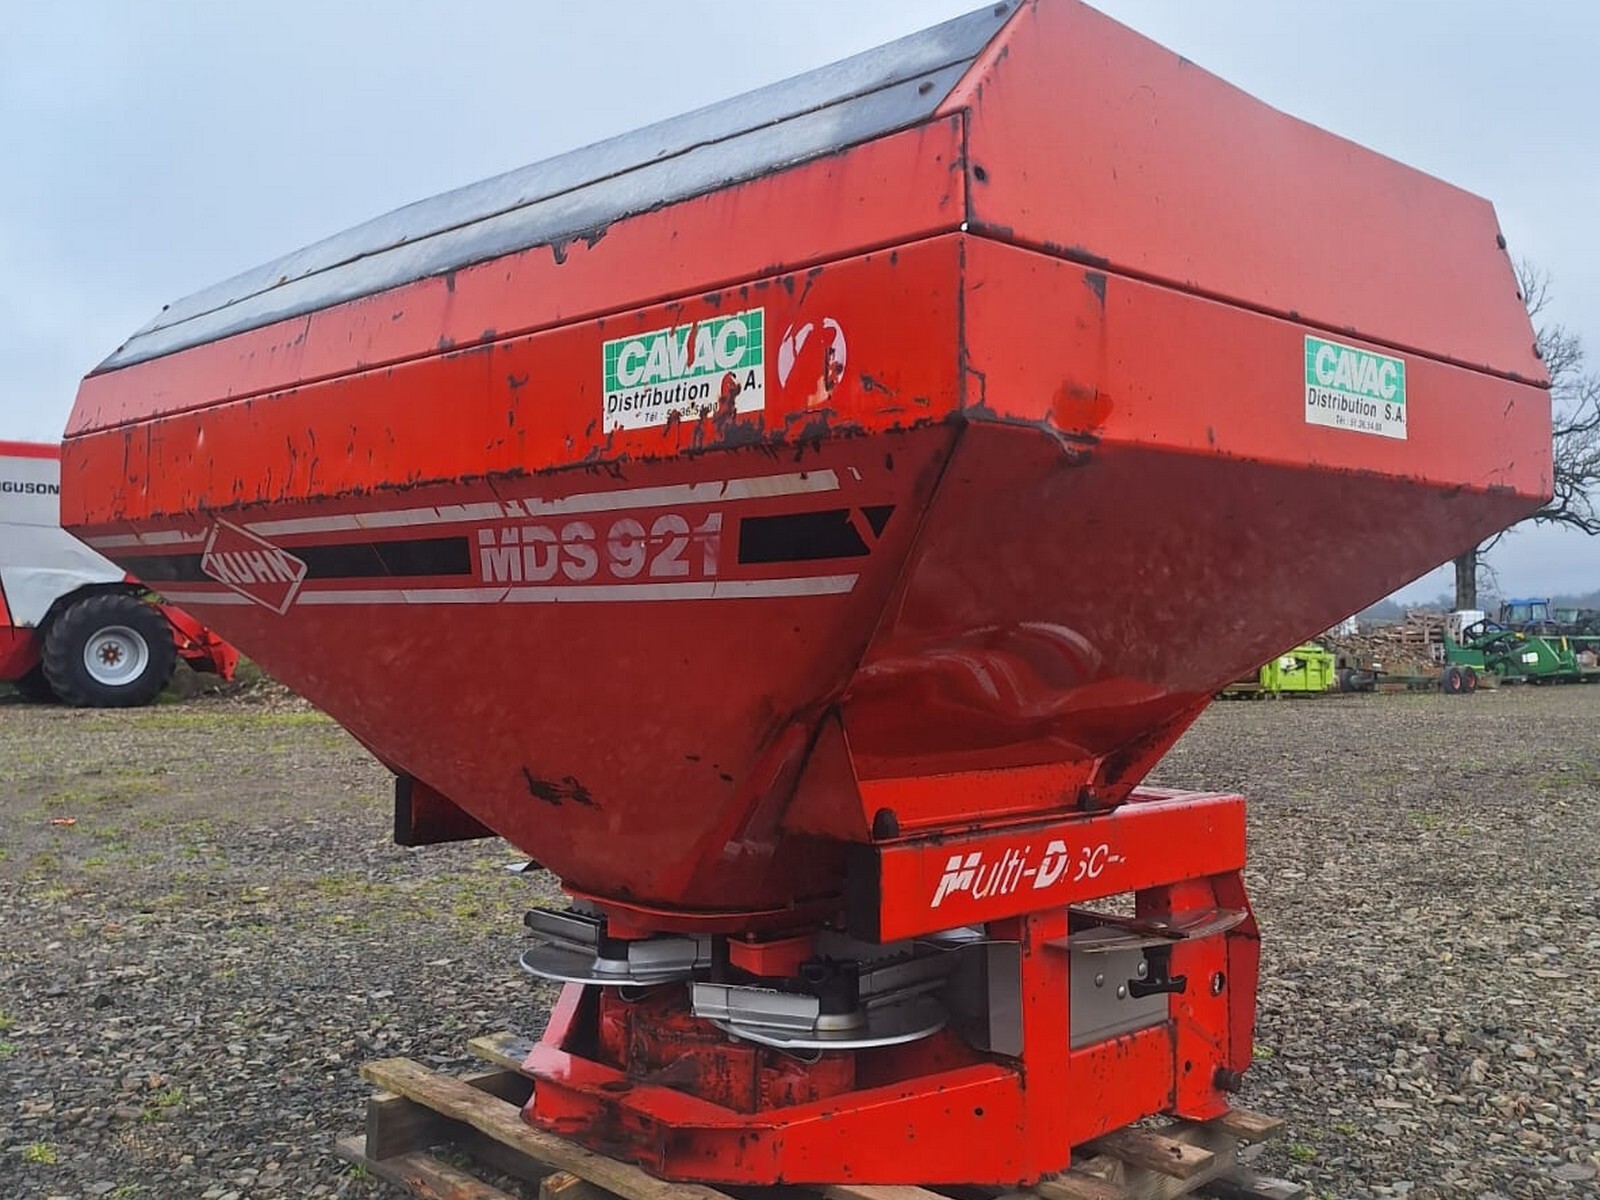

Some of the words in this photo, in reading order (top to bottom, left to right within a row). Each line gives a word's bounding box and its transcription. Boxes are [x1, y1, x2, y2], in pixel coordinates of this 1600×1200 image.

[616, 319, 748, 387] CAVAC
[1315, 344, 1397, 399] CAVAC
[607, 381, 710, 413] Distribution
[1307, 387, 1378, 417] Distribution
[1384, 403, 1406, 423] S.A.
[0, 481, 60, 494] GUSON
[478, 521, 599, 582] MDS
[607, 512, 723, 579] 921
[206, 549, 297, 584] KUHN
